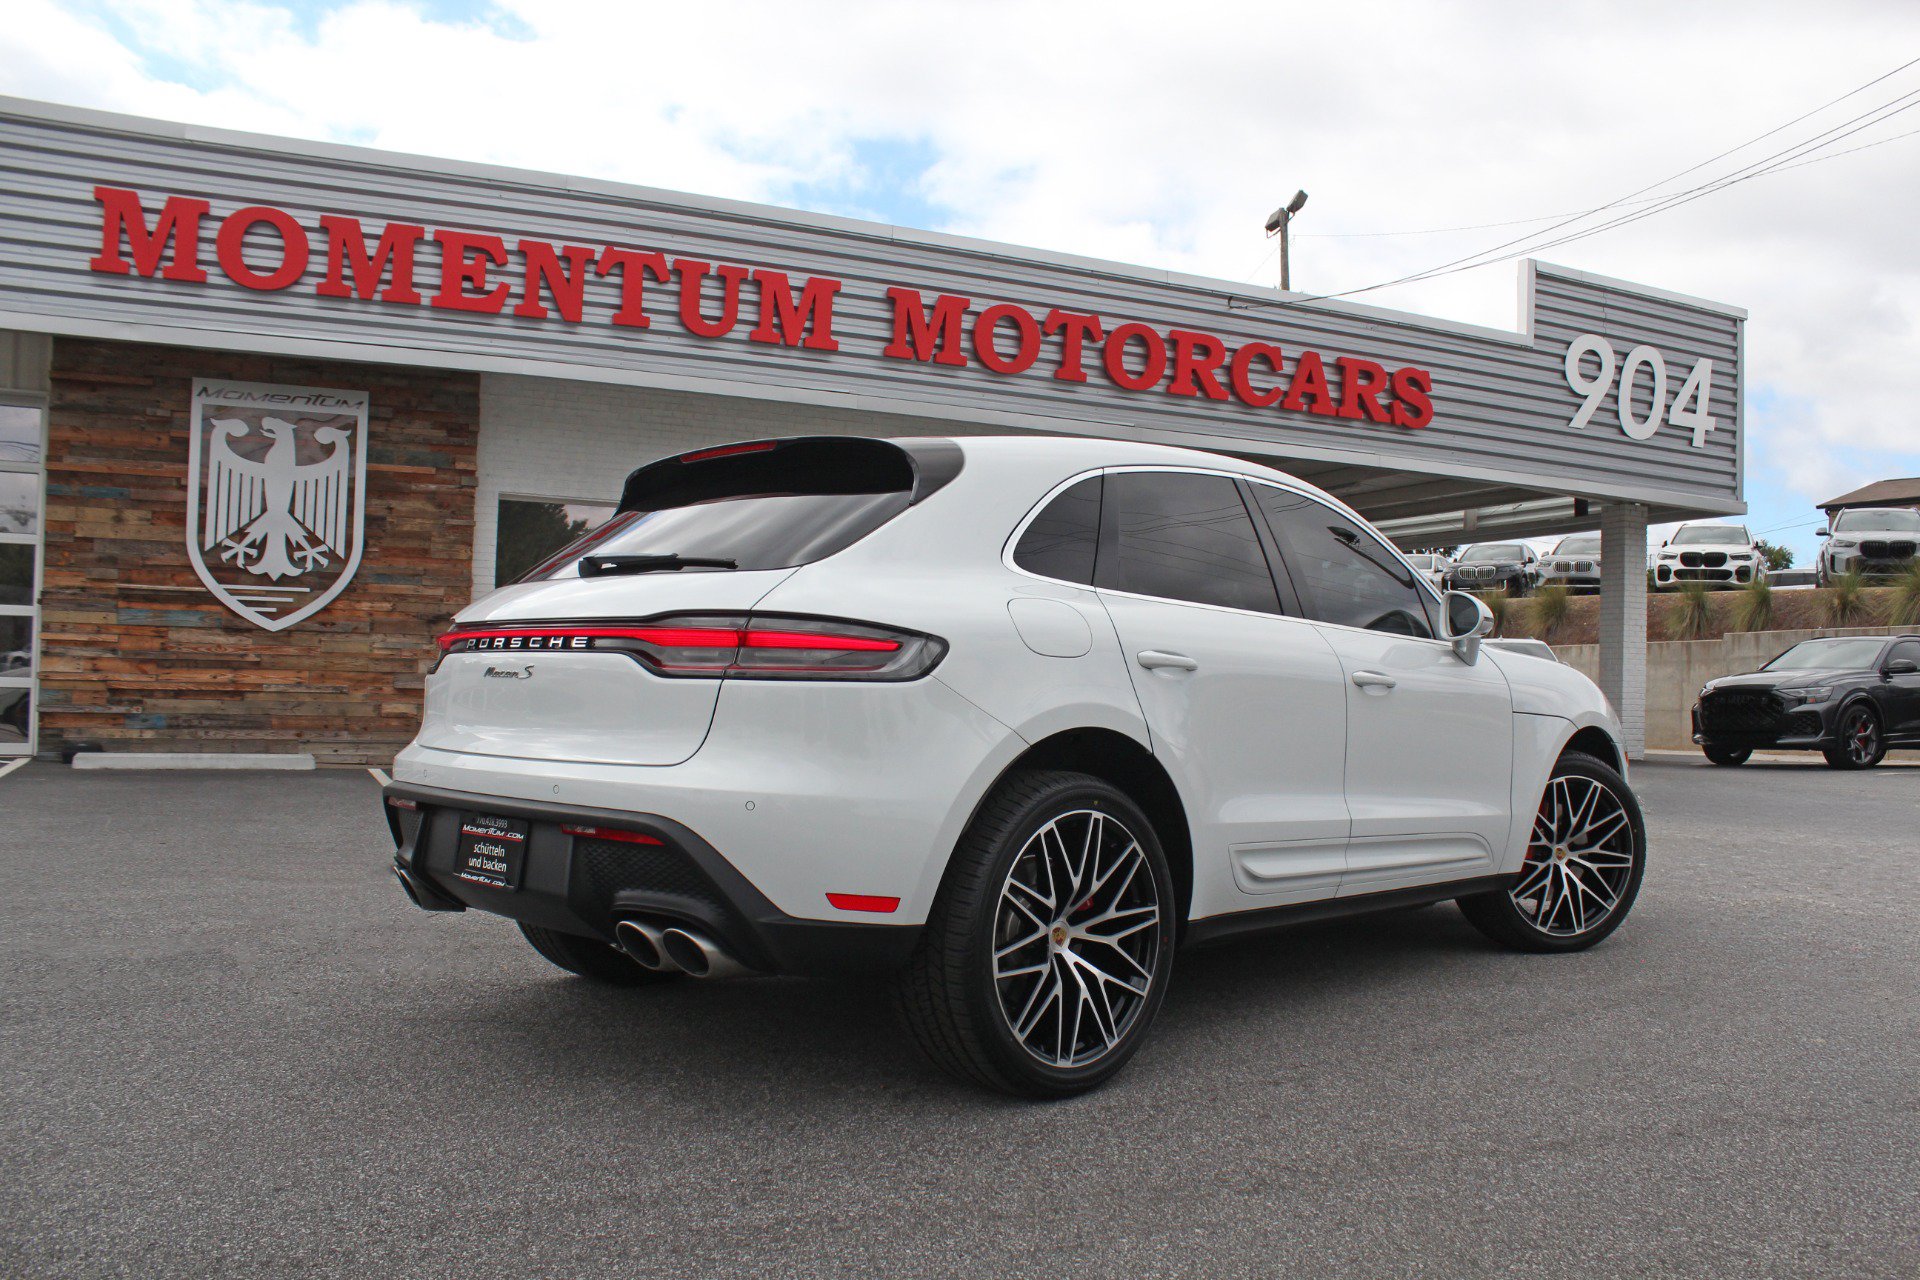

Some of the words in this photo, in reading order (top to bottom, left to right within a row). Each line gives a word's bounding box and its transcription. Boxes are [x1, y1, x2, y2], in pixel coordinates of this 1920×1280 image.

[90, 186, 841, 351] MOMENTUM
[883, 286, 1433, 430] MOTORCARS
[1565, 334, 1716, 448] 904
[466, 636, 589, 649] PORSCHE
[483, 666, 519, 679] Macan
[518, 664, 535, 680] S
[473, 841, 505, 858] schütteln
[468, 857, 482, 868] und
[483, 856, 507, 873] backen
